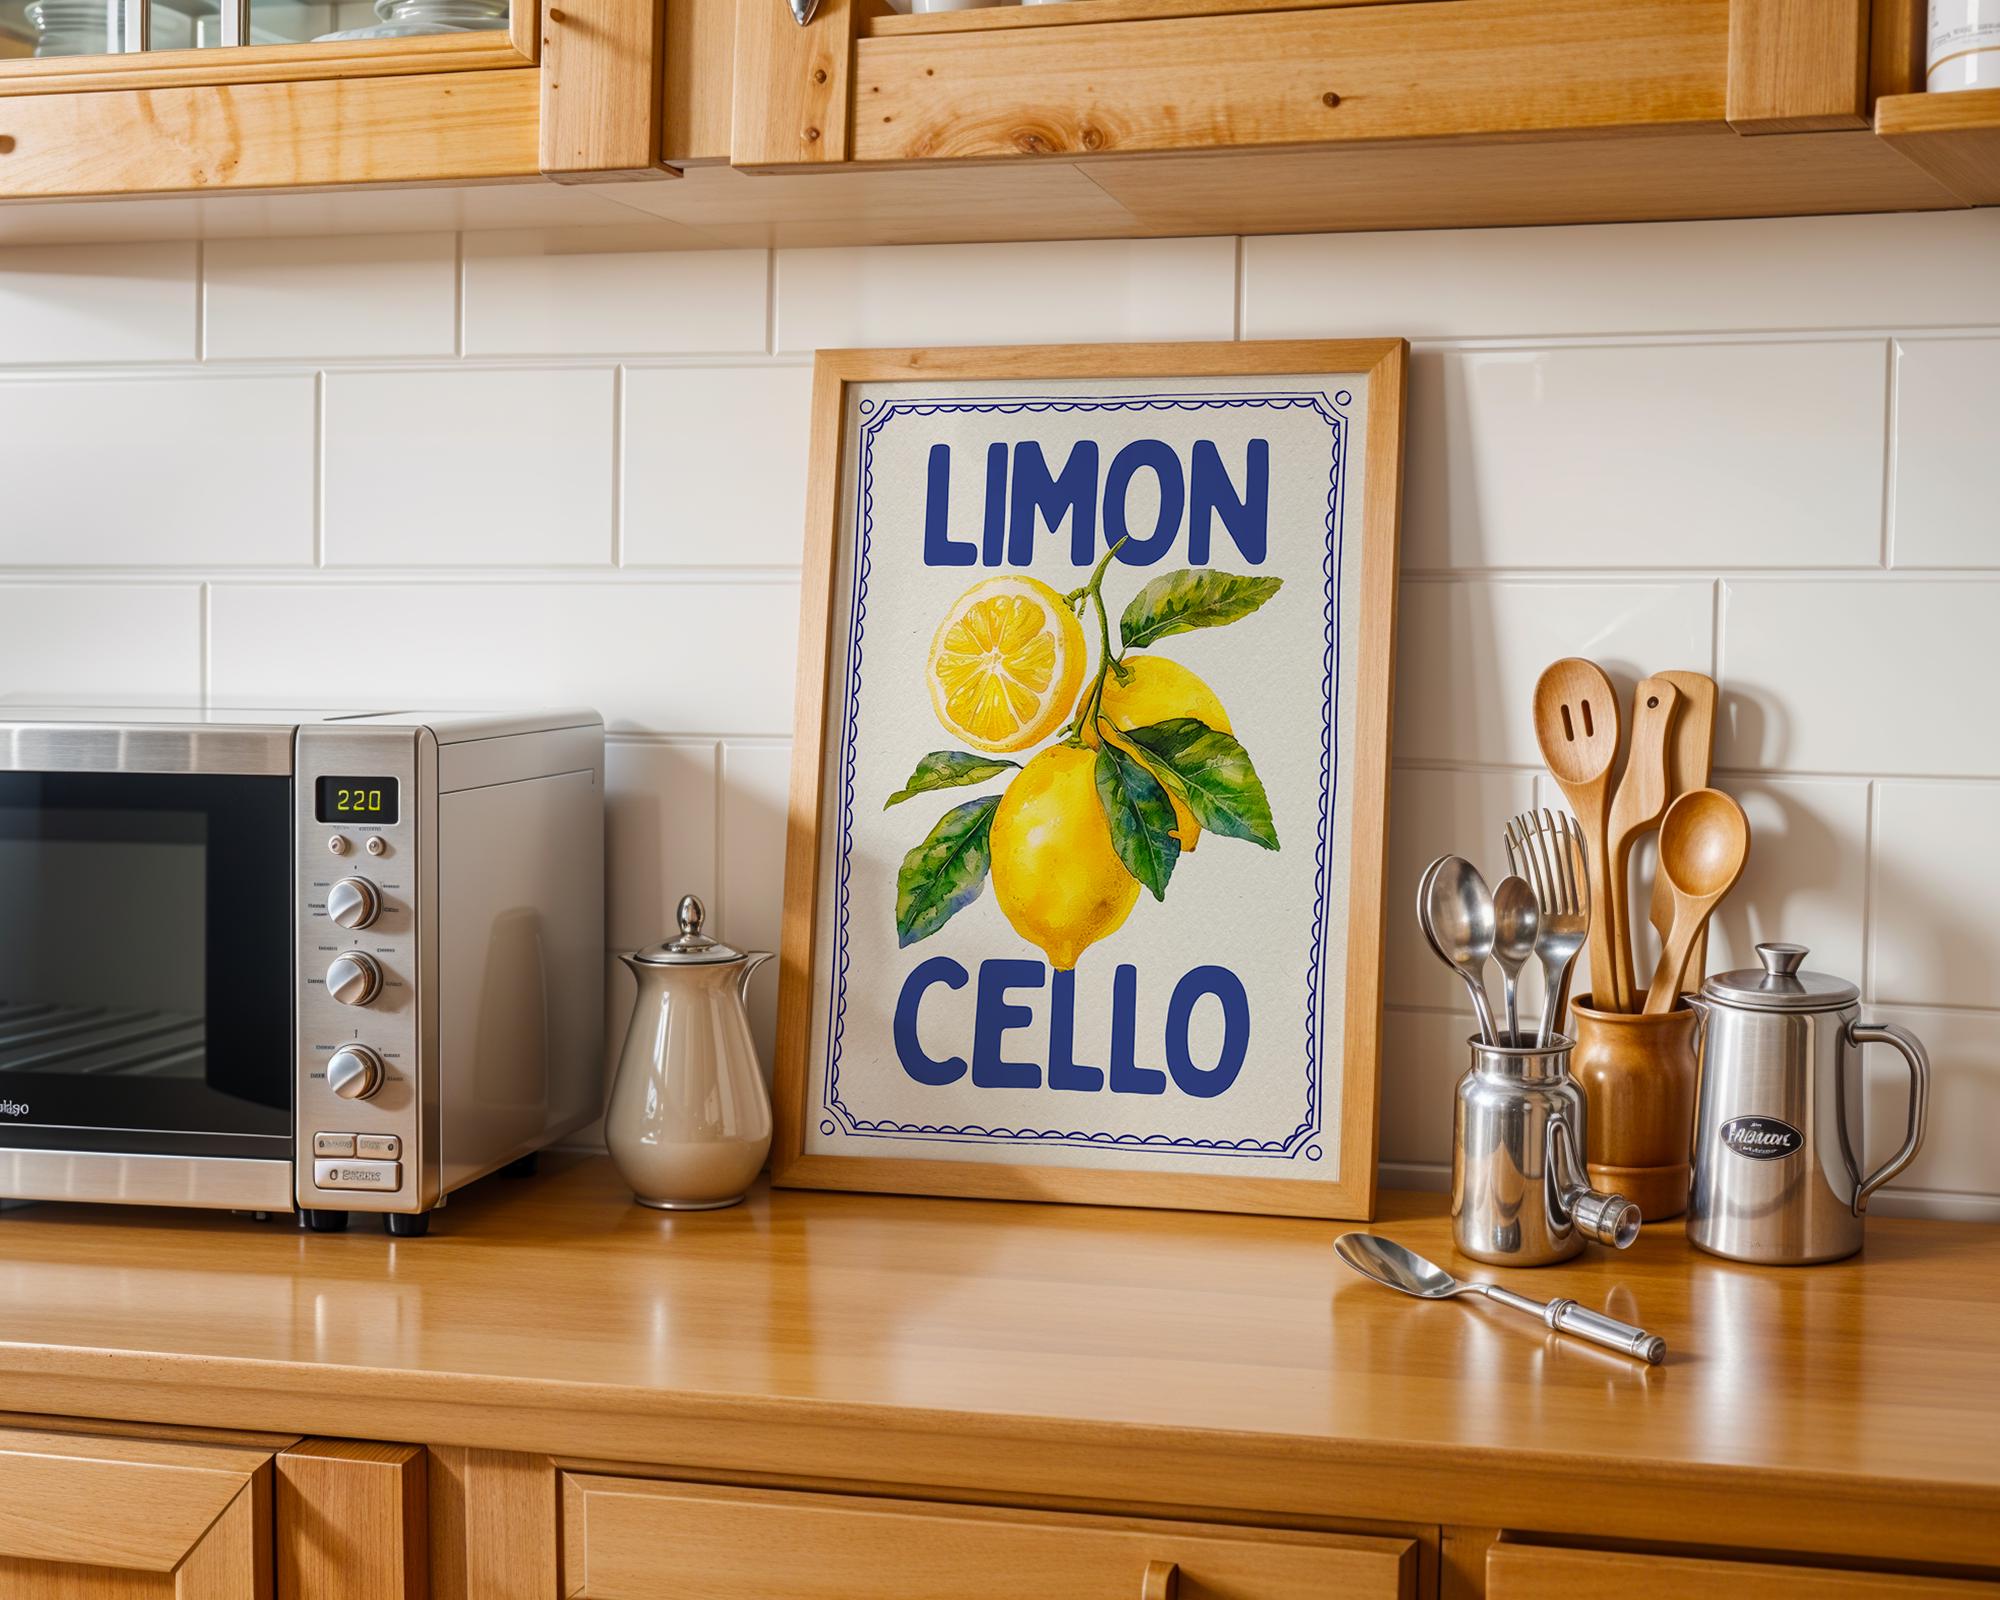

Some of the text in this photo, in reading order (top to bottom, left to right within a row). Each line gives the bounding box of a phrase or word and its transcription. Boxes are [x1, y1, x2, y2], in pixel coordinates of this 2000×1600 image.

[924, 439, 1270, 566] LIMON
[337, 789, 381, 811] 220
[893, 956, 1250, 1098] CELLO
